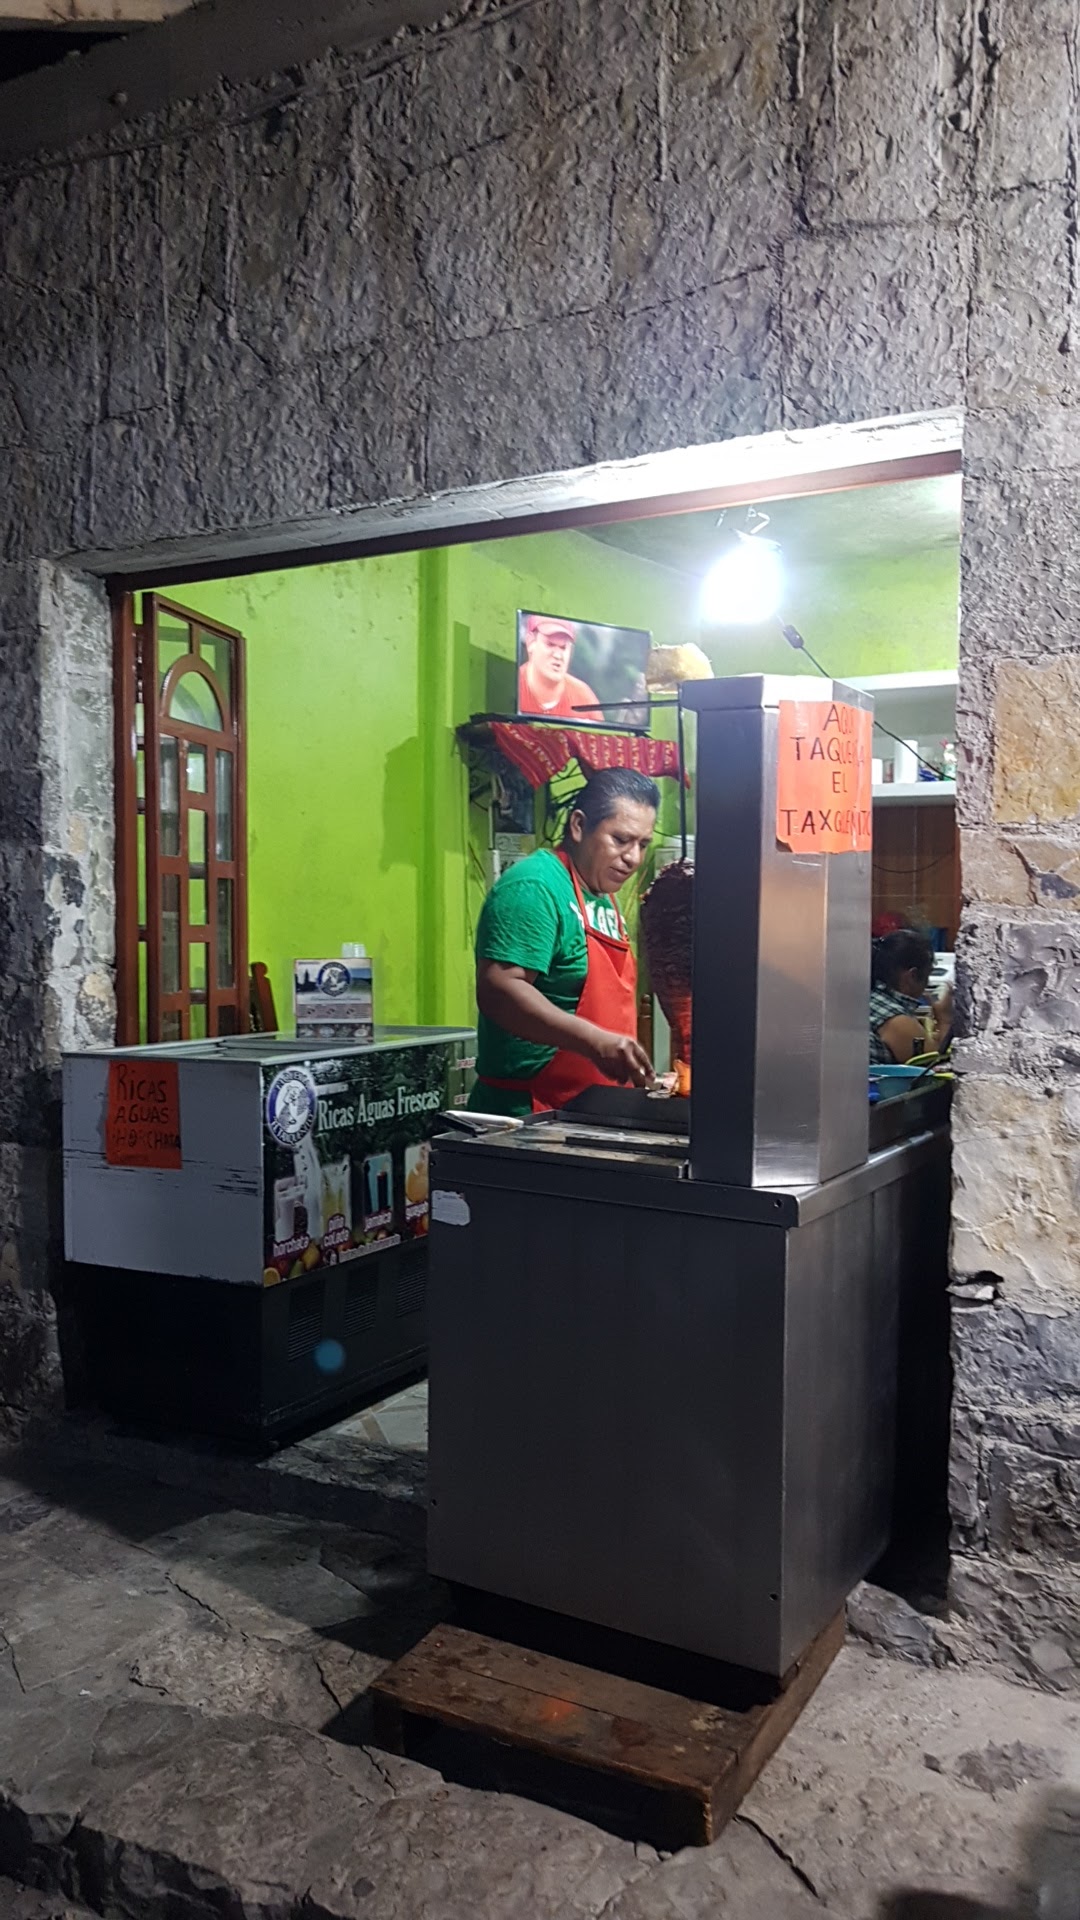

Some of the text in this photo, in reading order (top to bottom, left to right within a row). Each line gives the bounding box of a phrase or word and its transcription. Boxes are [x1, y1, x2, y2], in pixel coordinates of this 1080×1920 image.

[832, 771, 848, 793] EL
[116, 1063, 167, 1103] RICAS
[113, 1103, 169, 1125] AGUAS
[317, 1100, 354, 1131] Ricas
[357, 1093, 395, 1127] Aguas
[397, 1086, 440, 1115] Frescas
